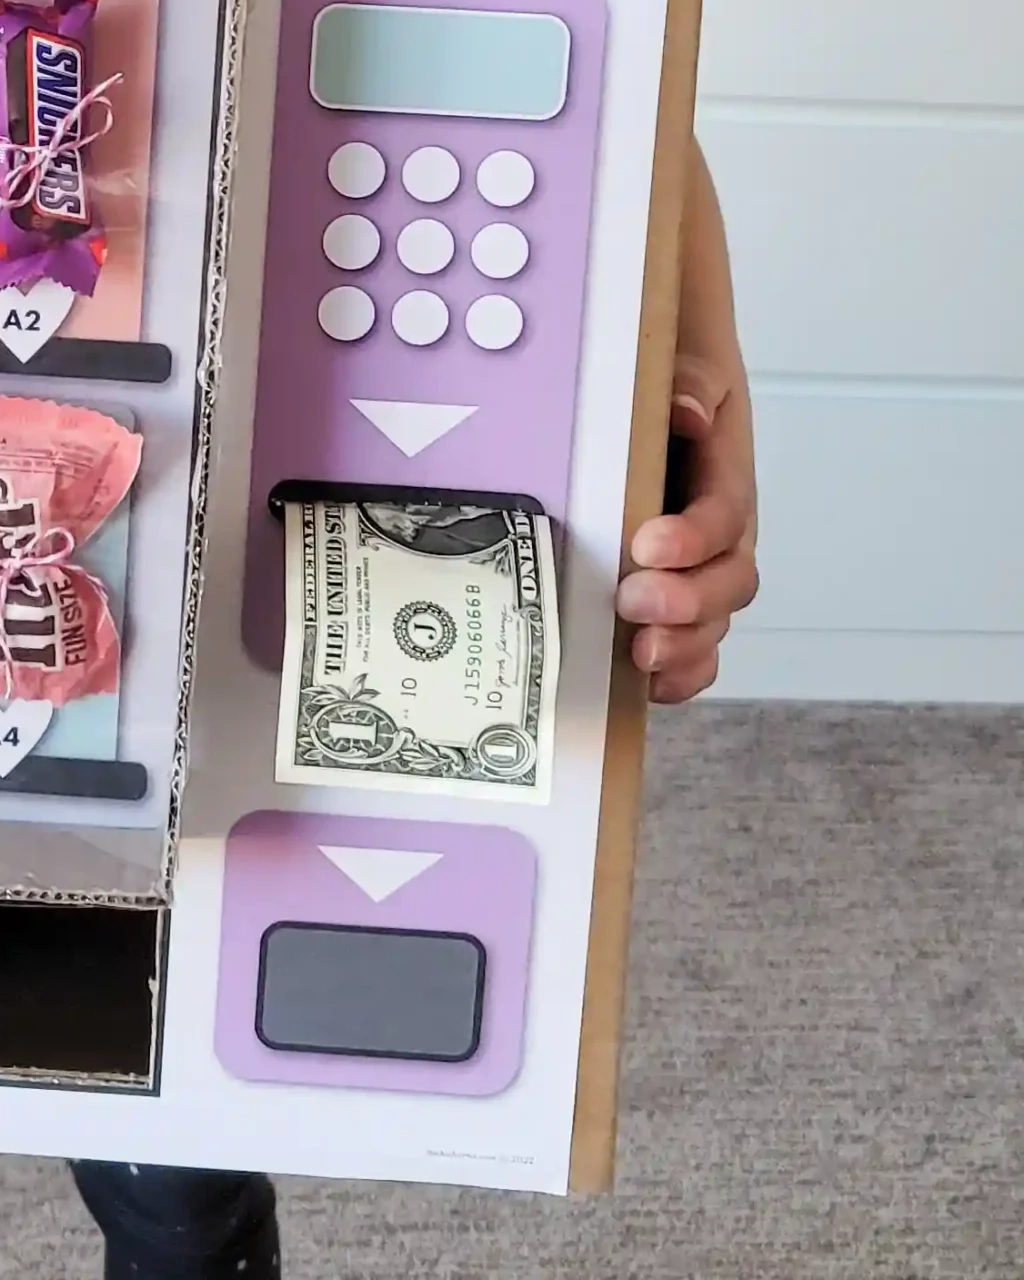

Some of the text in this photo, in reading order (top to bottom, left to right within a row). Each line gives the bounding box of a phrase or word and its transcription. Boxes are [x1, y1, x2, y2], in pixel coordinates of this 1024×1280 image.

[2, 309, 41, 332] A2
[304, 521, 315, 620] FEDERAL
[325, 537, 346, 616] UNITED
[516, 538, 538, 600] ONE
[53, 578, 87, 666] FUN SIZE
[413, 621, 438, 641] J
[324, 624, 345, 675] THE
[401, 677, 417, 697] 10
[485, 691, 503, 710] 10
[328, 721, 379, 746] 1
[484, 742, 518, 760] 1
